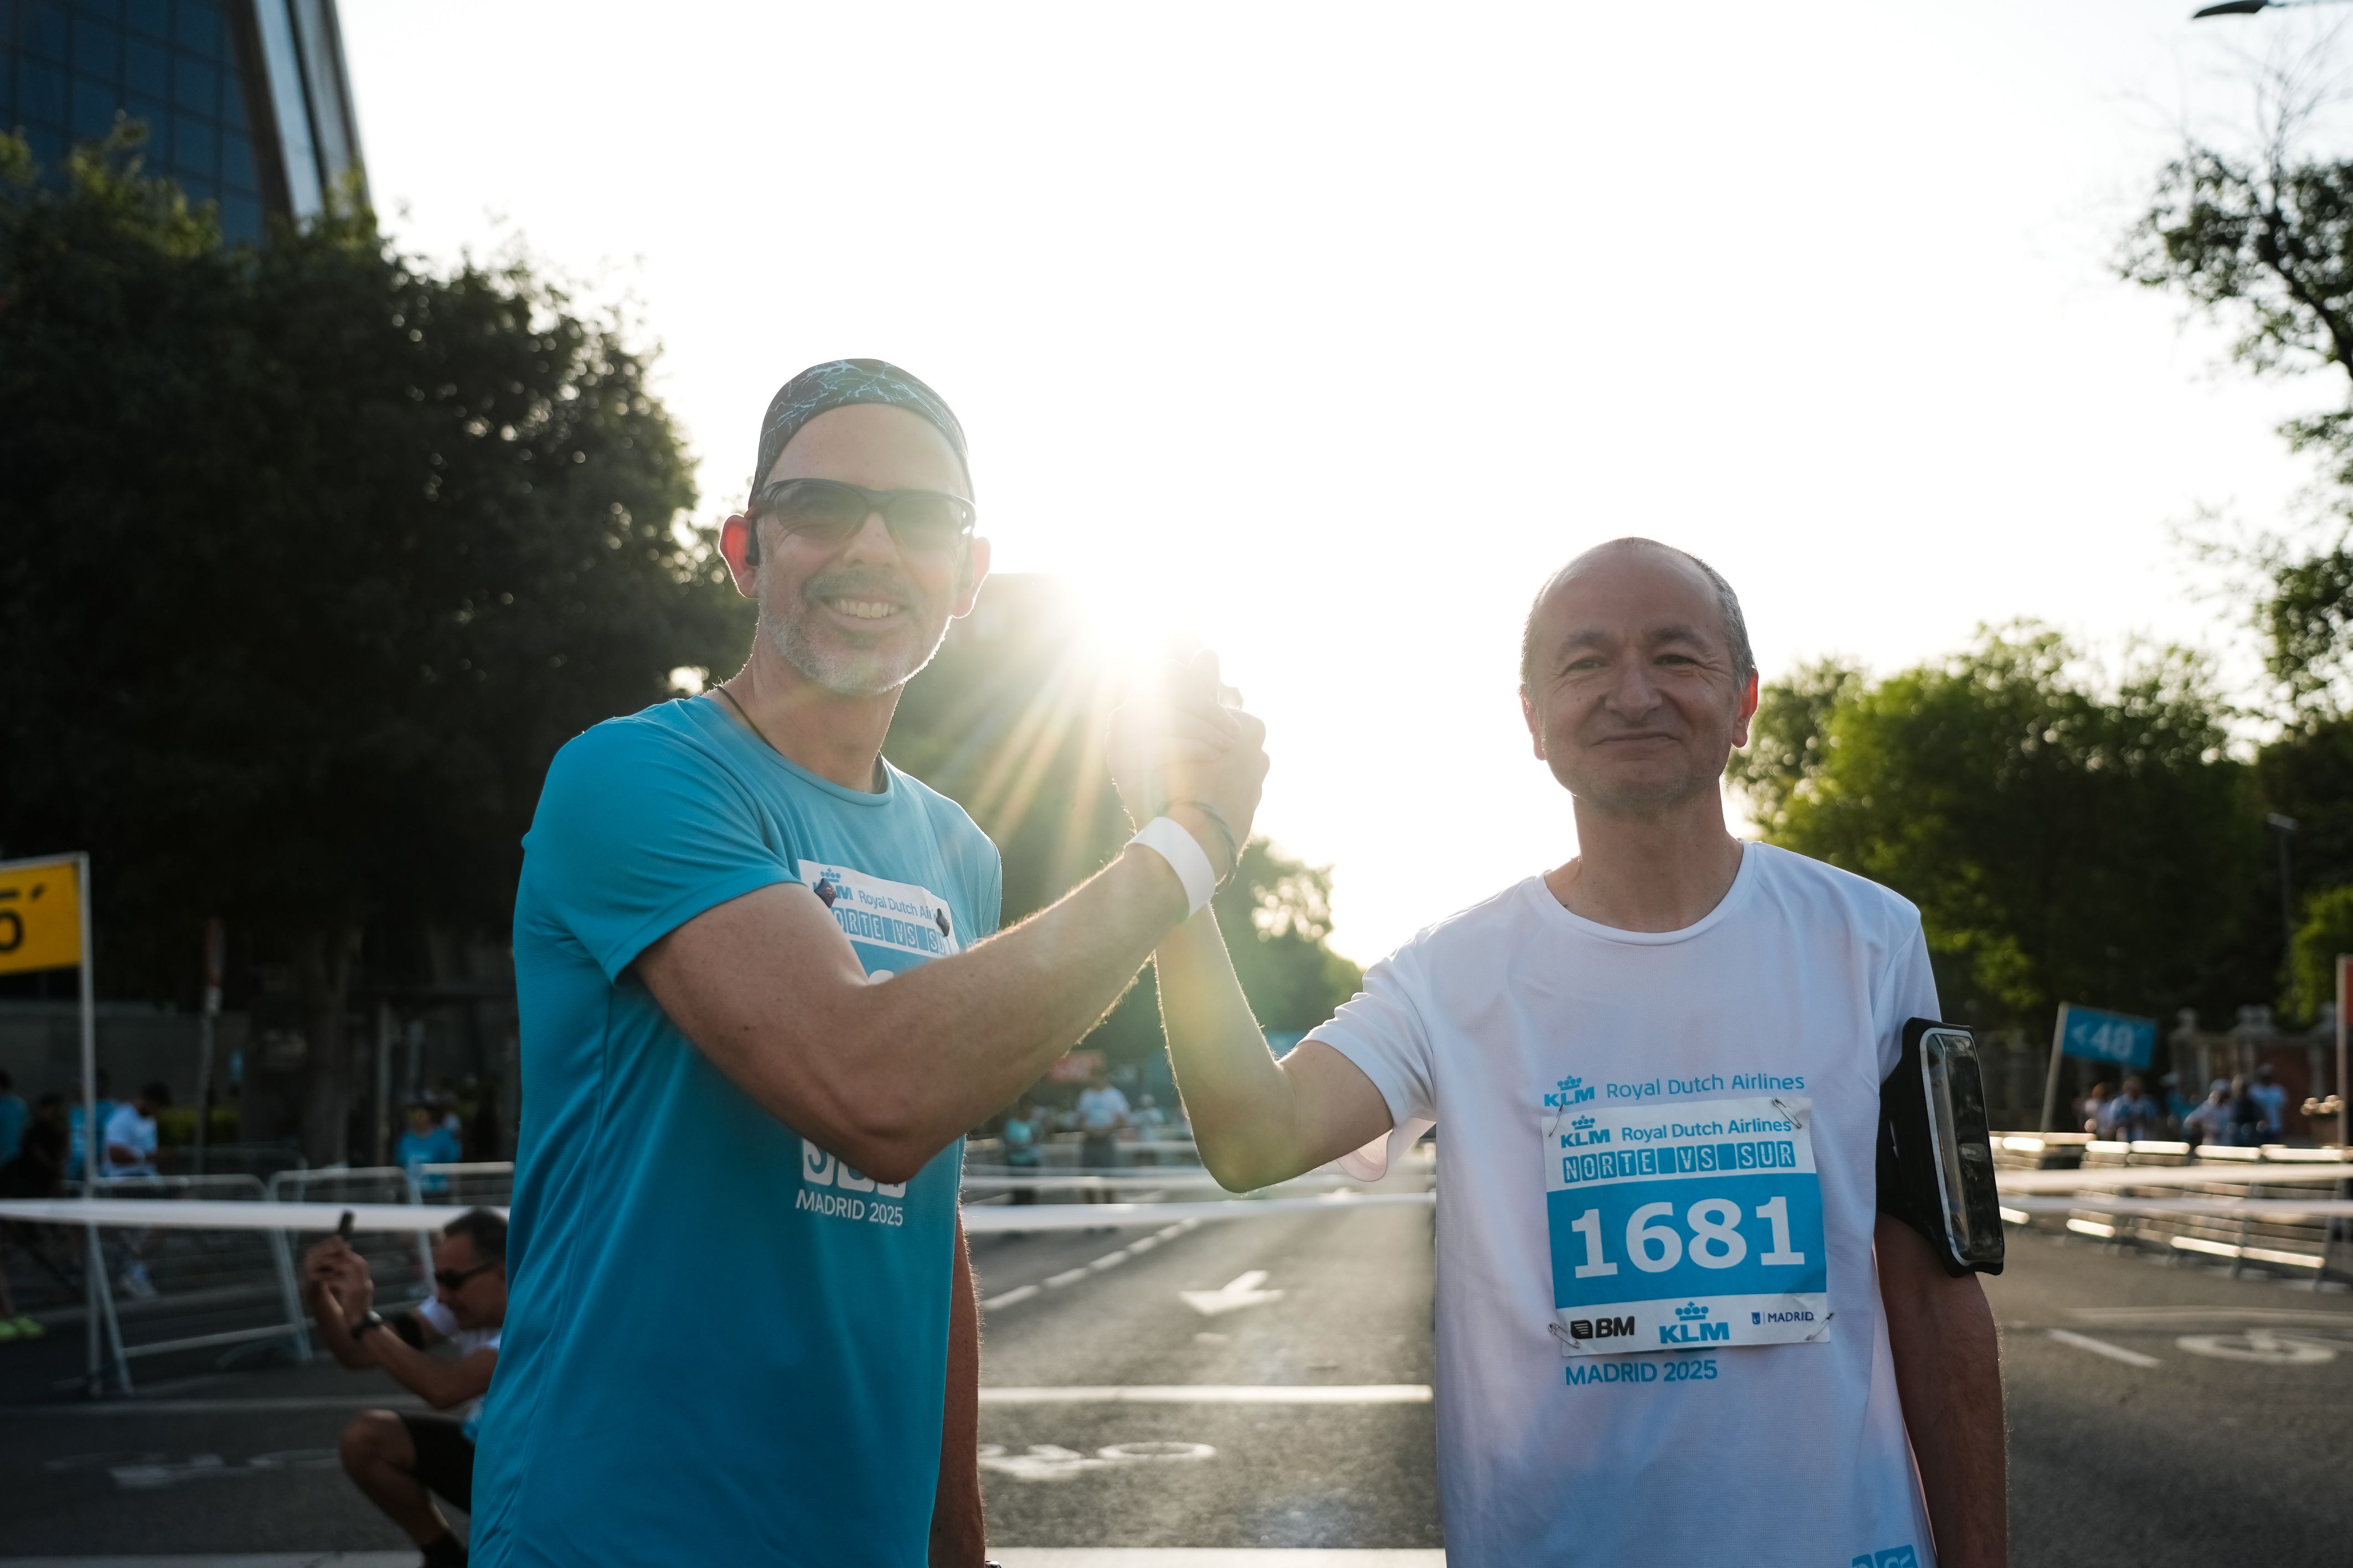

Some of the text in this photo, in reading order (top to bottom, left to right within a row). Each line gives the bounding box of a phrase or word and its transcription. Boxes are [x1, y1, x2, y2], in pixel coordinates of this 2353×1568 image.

[859, 889, 887, 909] Royal
[887, 897, 918, 917] Dutch
[895, 922, 915, 945] VS
[1544, 1073, 1805, 1107] KLM Royal Dutch Airlines
[1561, 1118, 1792, 1148] KLM Royal Dutch Airlines
[1565, 1144, 1792, 1181] NORTE VS SUR
[795, 1188, 904, 1227] MADRID 2025
[1571, 1196, 1805, 1279] 1681
[1596, 1316, 1635, 1337] BM
[1767, 1311, 1814, 1323] MADRID
[1659, 1322, 1730, 1344] KLM
[1565, 1359, 1718, 1385] MADRID 2025
